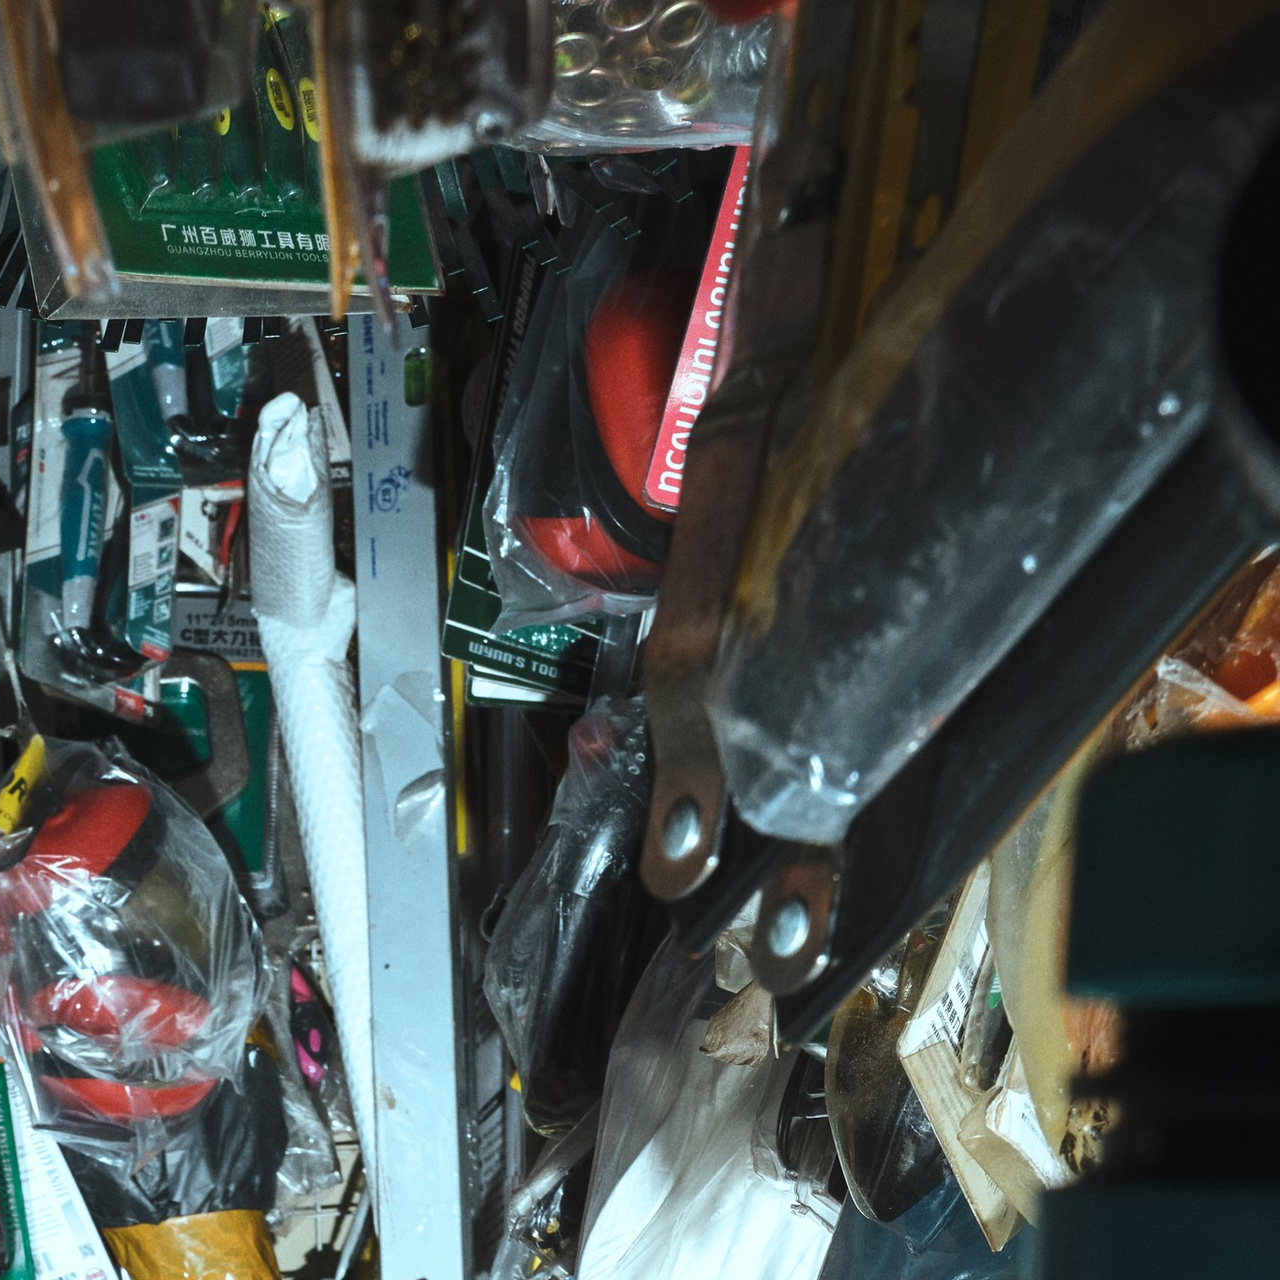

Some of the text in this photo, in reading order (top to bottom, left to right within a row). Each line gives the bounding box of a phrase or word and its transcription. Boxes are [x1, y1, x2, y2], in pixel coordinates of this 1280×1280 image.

[167, 244, 330, 264] GUANGZHOU BERRYLION TOOLS
